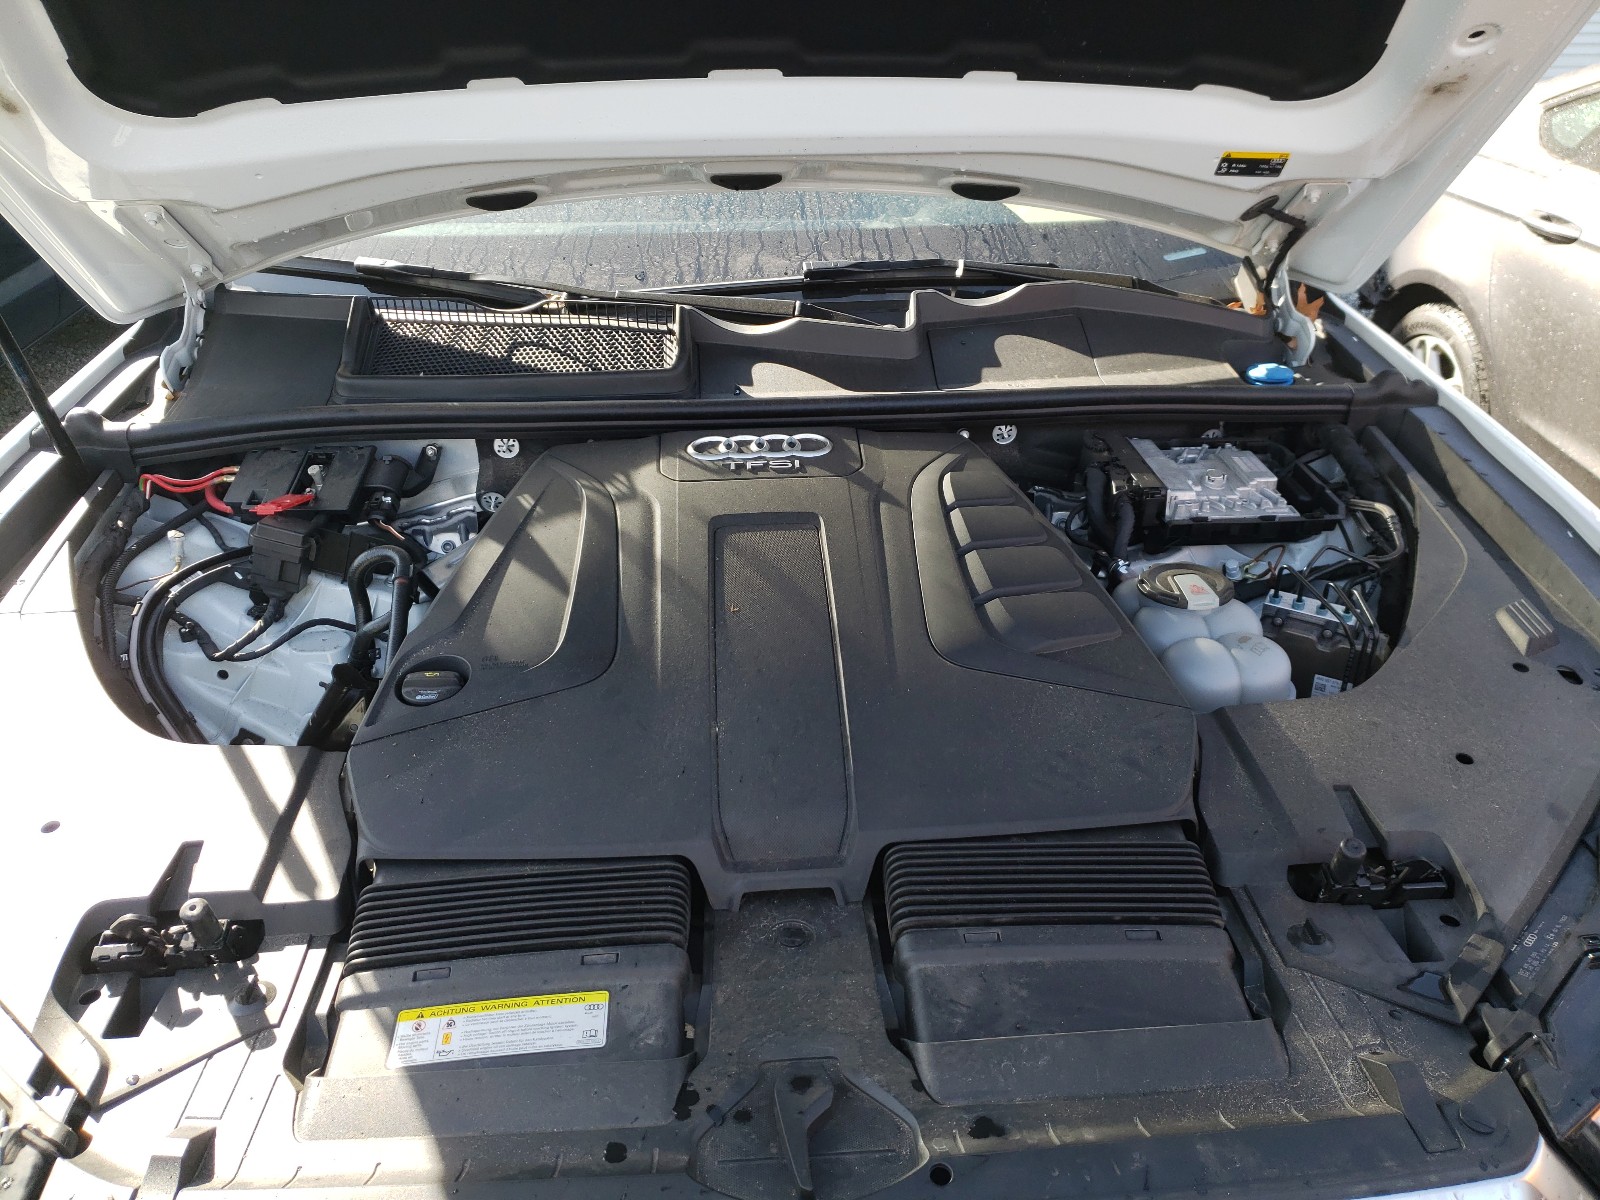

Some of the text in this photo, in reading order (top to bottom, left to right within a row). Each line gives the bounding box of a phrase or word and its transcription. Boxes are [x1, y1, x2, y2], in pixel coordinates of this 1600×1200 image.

[725, 459, 800, 470] TFSI
[429, 996, 586, 1017] ACHTUNG WARNING ATTENTION
